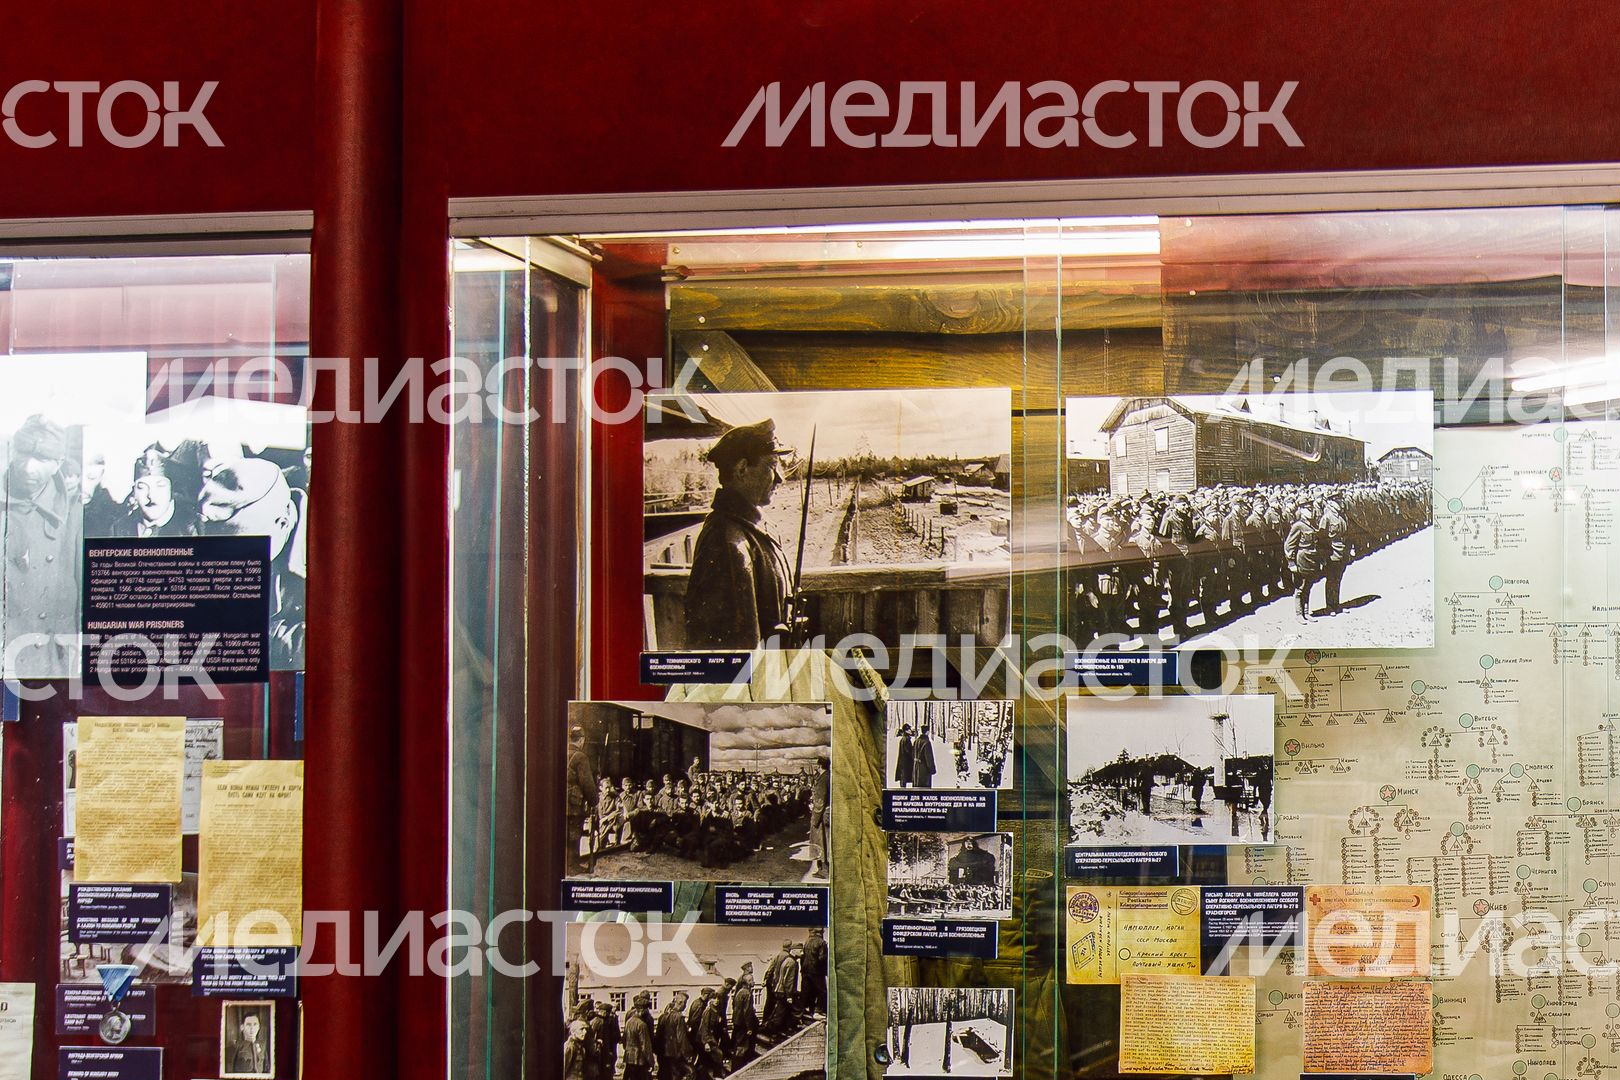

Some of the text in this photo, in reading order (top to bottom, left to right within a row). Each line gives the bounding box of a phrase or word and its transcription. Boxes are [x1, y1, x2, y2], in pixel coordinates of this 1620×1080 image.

[89, 548, 194, 557] ВЕНГЕРСКИЕ ВОЕННОПЛЕННЫЕ
[87, 621, 184, 629] HUNGARIAN WAR PRISONERS
